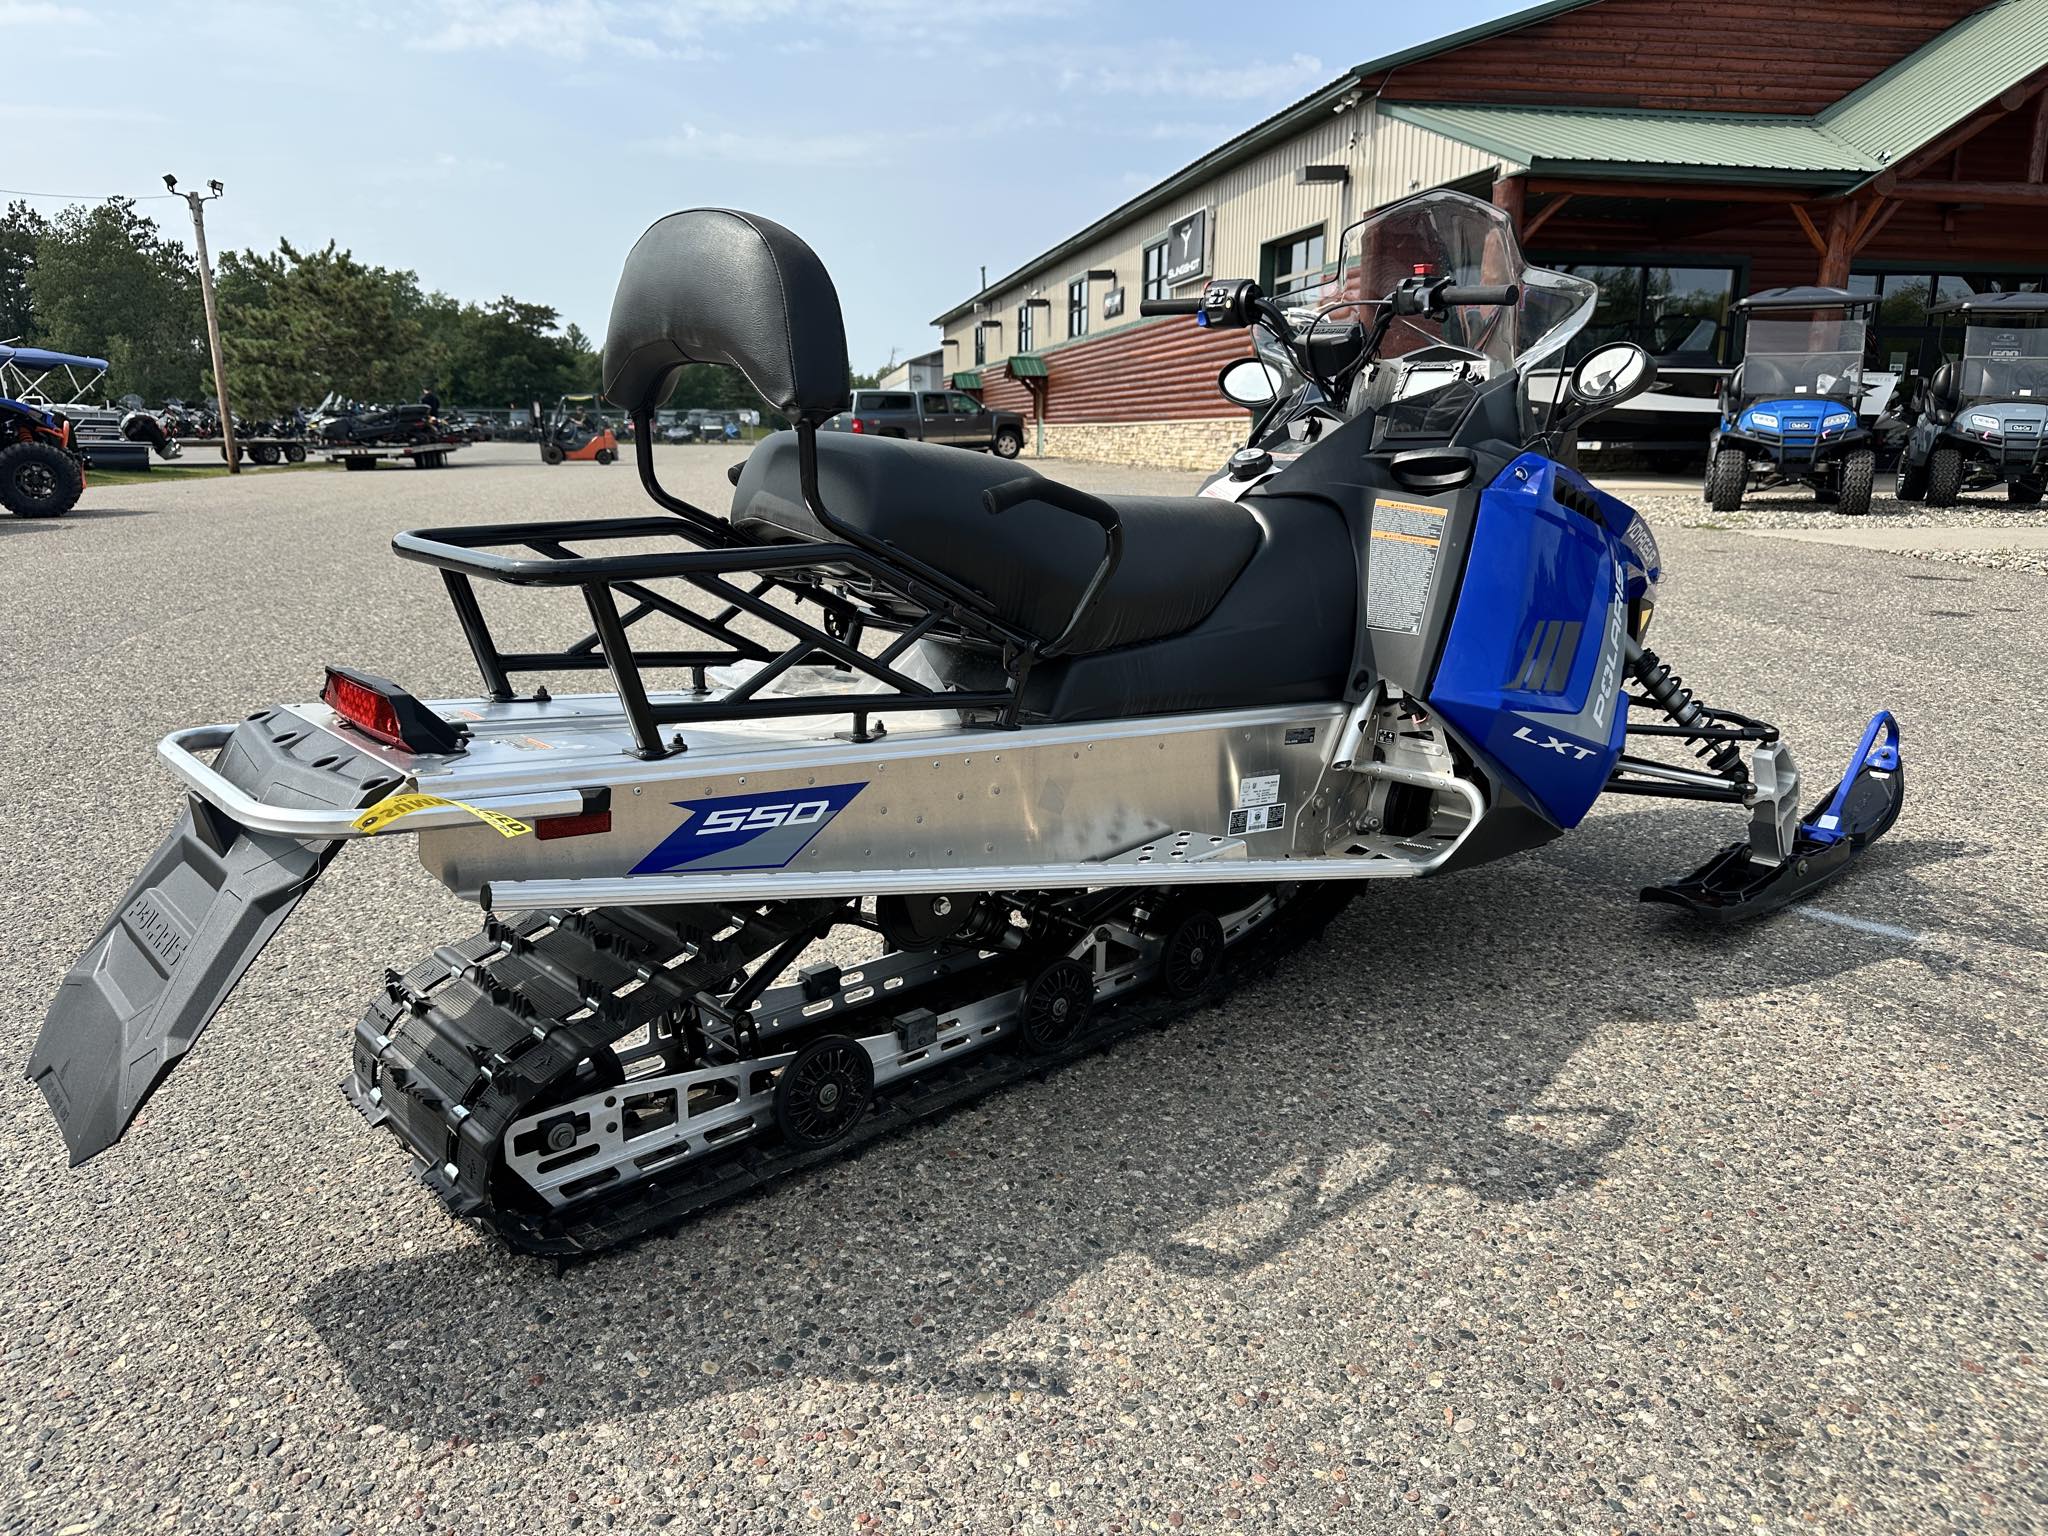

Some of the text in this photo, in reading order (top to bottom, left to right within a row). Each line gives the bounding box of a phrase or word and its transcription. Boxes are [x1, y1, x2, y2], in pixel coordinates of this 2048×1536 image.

[1626, 517, 1658, 566] VOYAGEUR
[1592, 559, 1625, 729] POLARIS
[1512, 726, 1598, 760] LXT
[695, 800, 830, 836] 550
[126, 897, 190, 968] POLARIS
